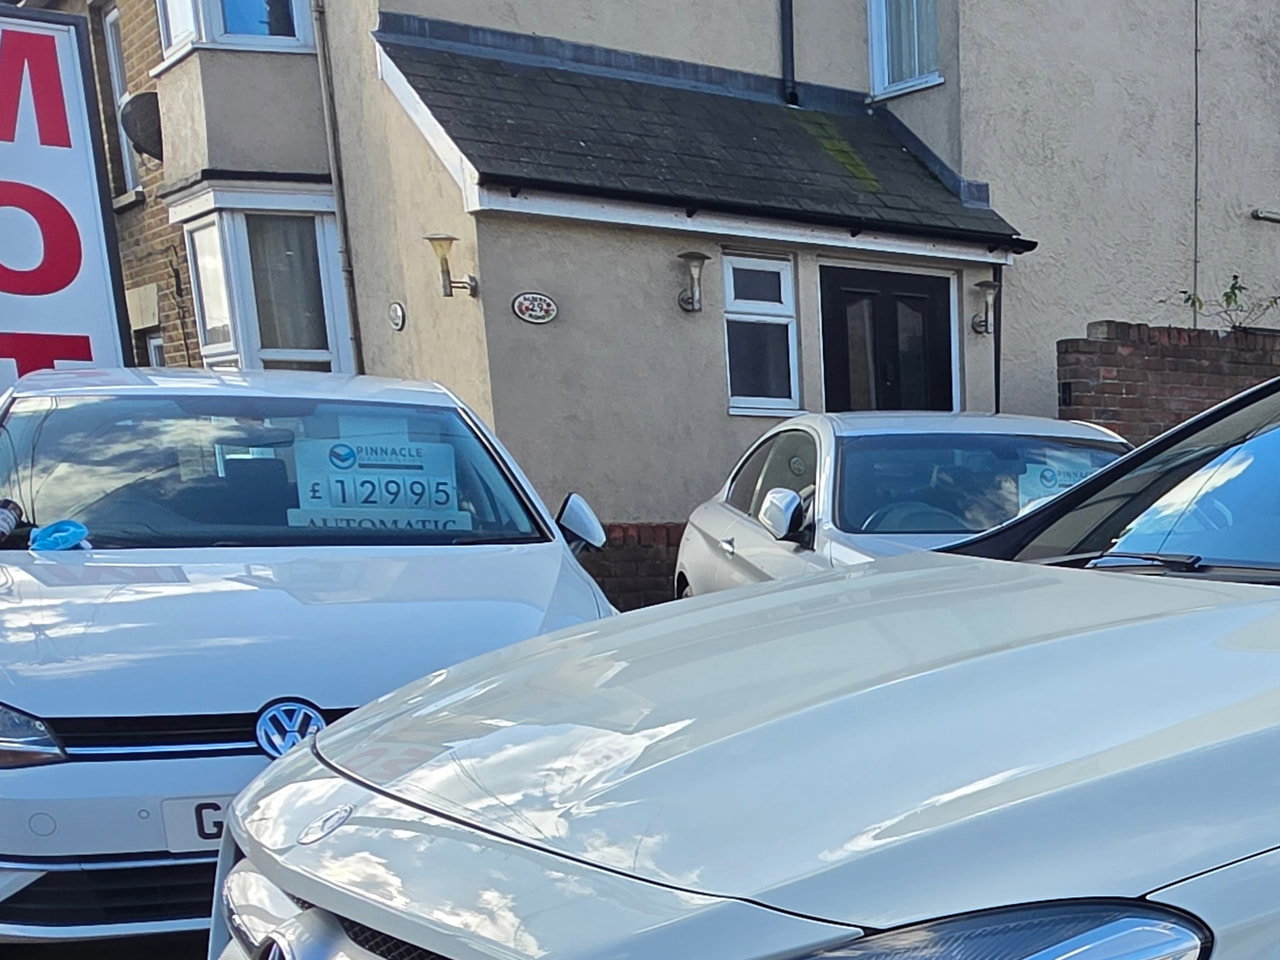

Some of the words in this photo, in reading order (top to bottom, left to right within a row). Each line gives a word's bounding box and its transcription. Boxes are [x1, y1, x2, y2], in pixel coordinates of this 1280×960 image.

[530, 302, 543, 312] 29
[356, 446, 424, 458] PINNACLE
[306, 517, 456, 530] AUTOMATIC
